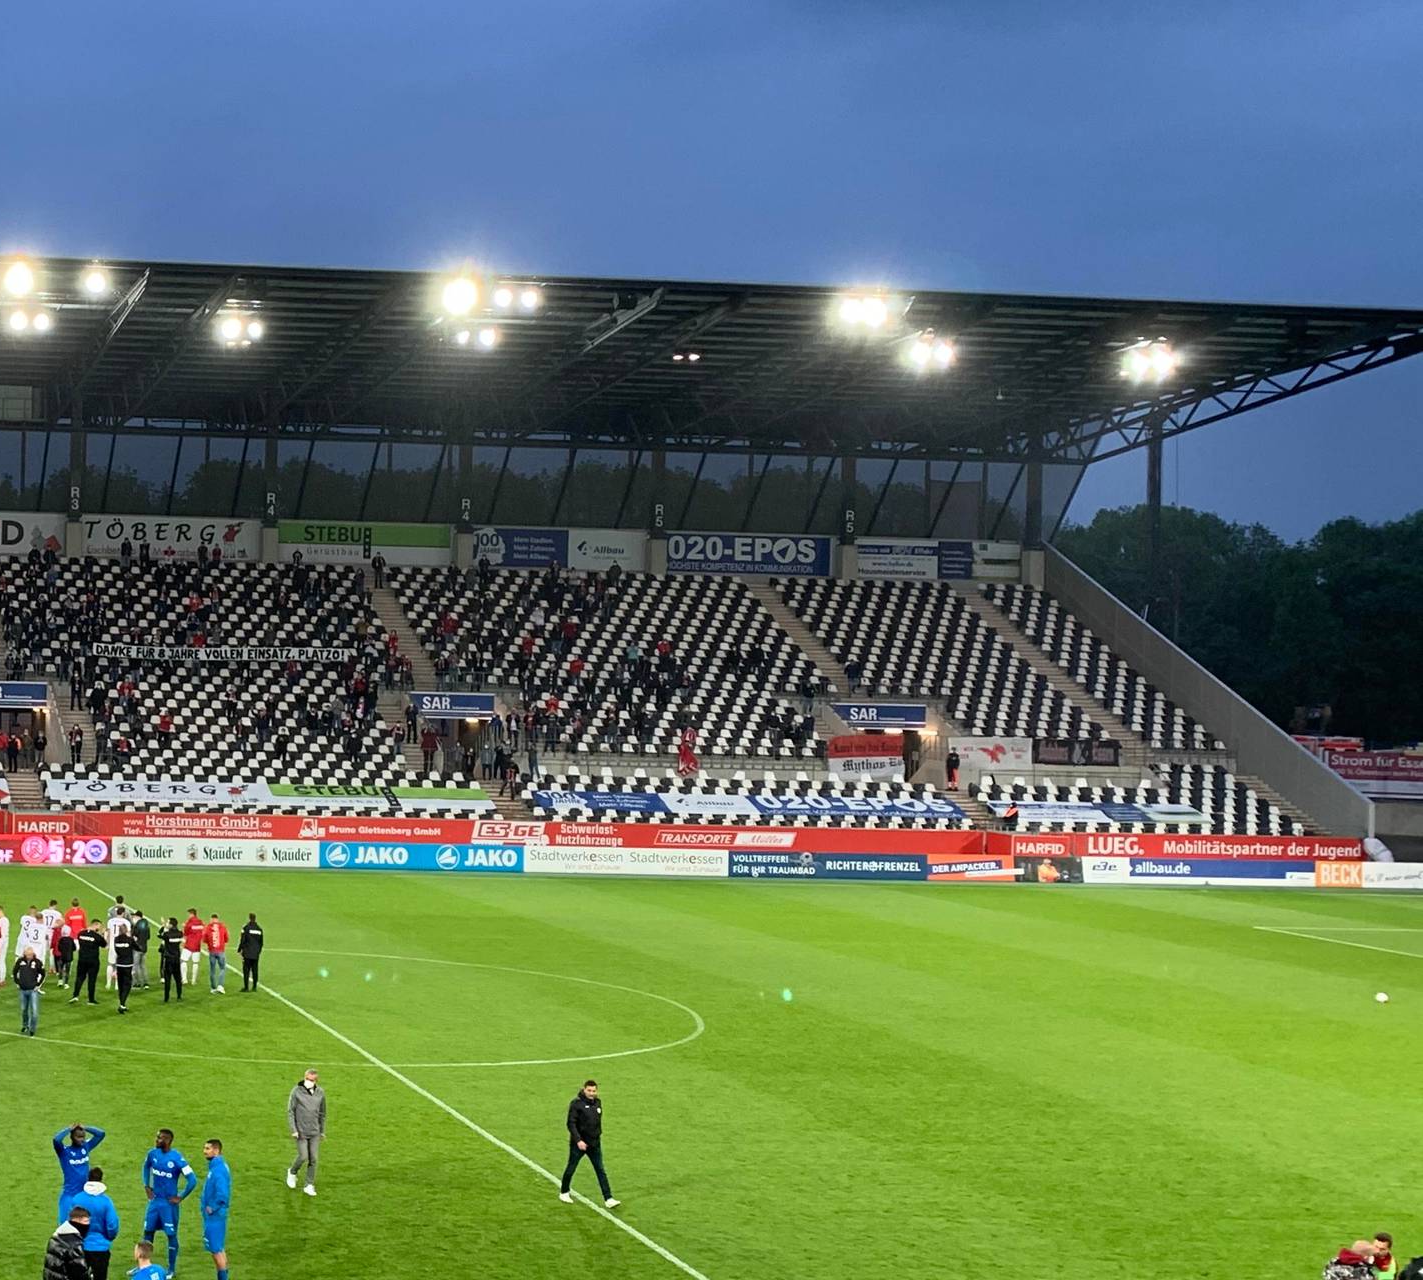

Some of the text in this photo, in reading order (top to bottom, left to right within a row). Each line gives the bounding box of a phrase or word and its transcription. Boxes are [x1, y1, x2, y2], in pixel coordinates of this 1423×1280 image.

[85, 518, 215, 544] TÖBERG
[594, 545, 625, 555] Allbau
[668, 535, 816, 564] 020-EPOS
[96, 645, 132, 656] DANKE
[169, 649, 201, 660] JAHRE
[205, 649, 244, 660] VOLLEN
[299, 649, 344, 660] PLATZO!
[422, 696, 450, 709] SAR
[850, 707, 877, 720] SAR
[842, 759, 886, 773] Mythos
[1331, 755, 1372, 766] Strom
[1376, 757, 1394, 767] für
[18, 821, 70, 833] HARFID
[146, 815, 216, 828] Horstmann
[220, 817, 259, 828] GmbH
[329, 825, 357, 835] Bruno
[414, 827, 441, 837] GmbH
[555, 834, 623, 847] Nutzfahrzeuge
[661, 833, 733, 845] TRANSPORTE
[133, 844, 312, 862] Stauder Stauder Stauder
[1016, 842, 1065, 855] HARFID
[1088, 836, 1361, 860] LUEG. Mobilitätspartner der Jugend
[355, 847, 518, 867] JAKO JAKO
[530, 849, 623, 863] Stadtwerkessen
[630, 851, 723, 865] Stadtwerkessen
[733, 854, 789, 864] VOLLTREFFER!
[733, 865, 749, 873] FÜR
[768, 867, 816, 876] TRAUMBAD
[932, 861, 999, 874] DER ANPACKER.
[1135, 863, 1191, 876] allbau.de
[1320, 864, 1361, 884] BECK
[45, 915, 54, 926] 17
[33, 929, 39, 941] 3
